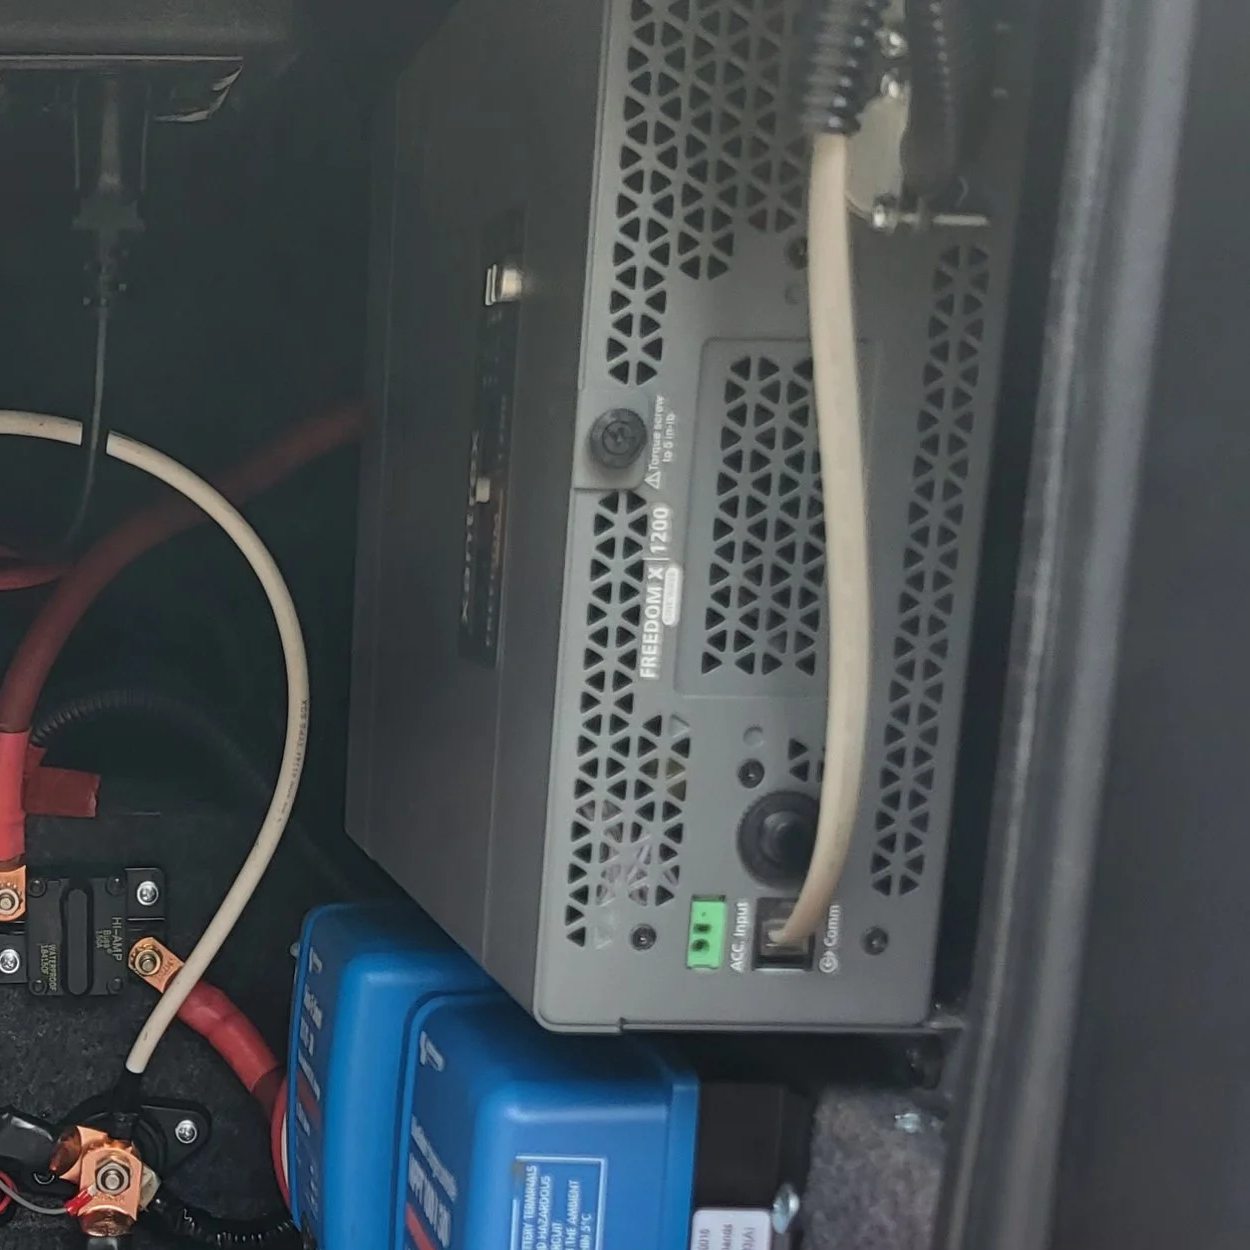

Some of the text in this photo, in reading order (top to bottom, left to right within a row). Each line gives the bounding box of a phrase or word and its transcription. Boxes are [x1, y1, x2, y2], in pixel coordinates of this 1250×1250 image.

[648, 394, 664, 471] Torque screw
[639, 507, 670, 678] FREEDOM X 1200
[111, 916, 123, 961] HI-AMP
[730, 901, 749, 973] ACC. Input
[824, 904, 840, 947] Comm
[48, 943, 58, 992] WATERPROOF
[523, 1165, 538, 1219] TERMINALS
[537, 1175, 551, 1239] HAZARDOUS
[566, 1180, 580, 1224] AMBIENT
[565, 1227, 577, 1245] THE
[580, 1213, 592, 1232] 5°C
